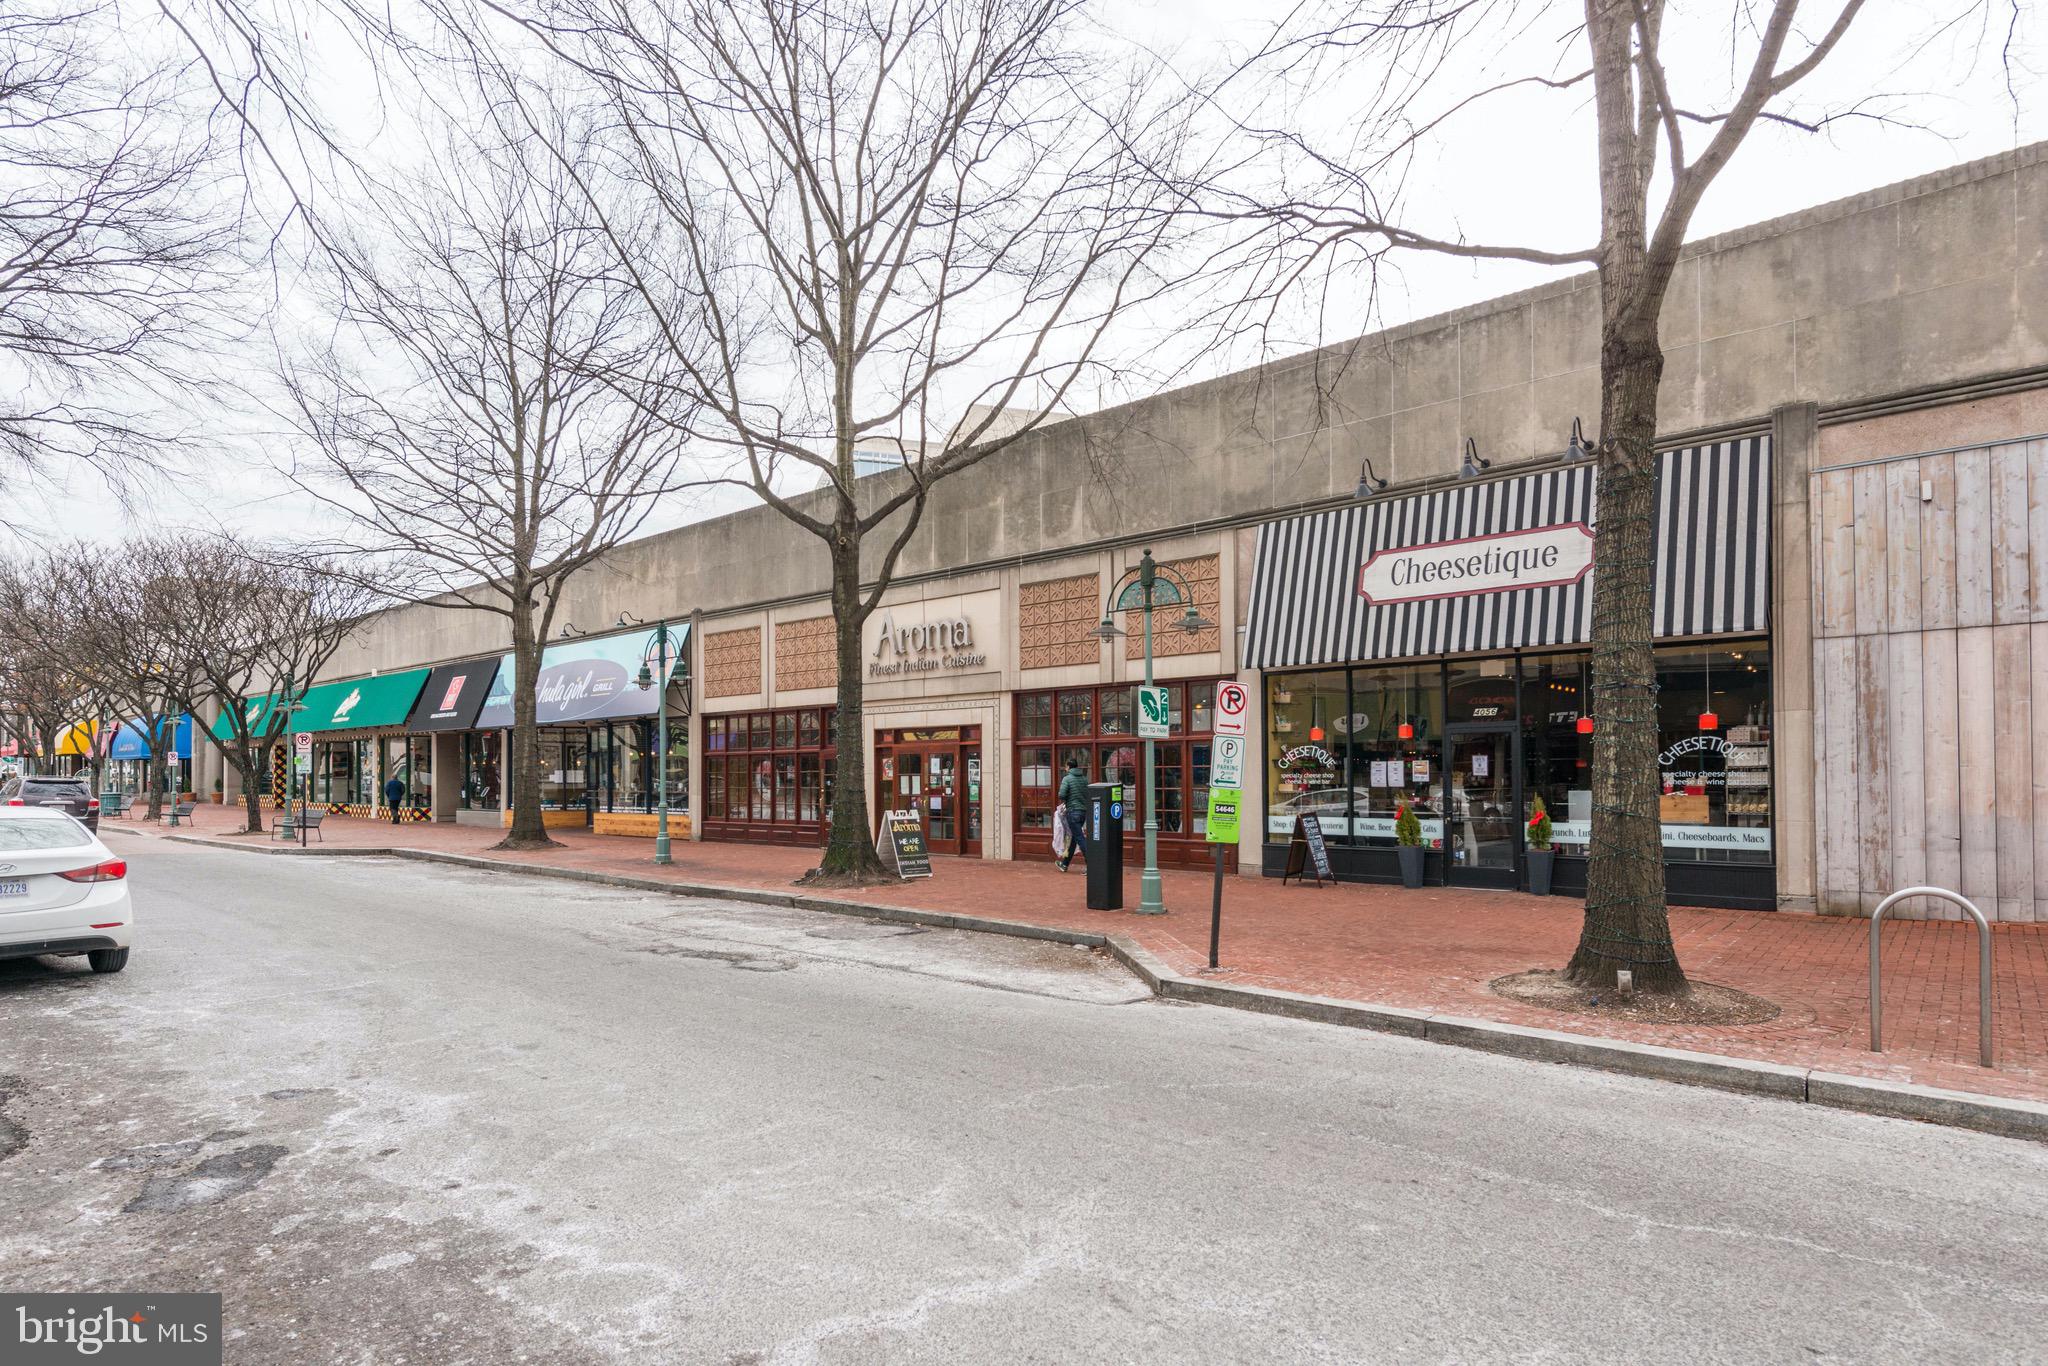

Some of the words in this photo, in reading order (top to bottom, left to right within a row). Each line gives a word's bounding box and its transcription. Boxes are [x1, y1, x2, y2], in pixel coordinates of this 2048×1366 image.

[1390, 544, 1559, 587] Cheesetique
[873, 613, 974, 658] Aroma
[869, 660, 903, 677] Finest
[904, 657, 940, 673] Indian
[942, 653, 986, 670] Cuisine
[592, 682, 614, 692] GRILL
[1161, 692, 1168, 704] 2
[1474, 708, 1497, 717] 4056
[1278, 745, 1337, 770] CHEESETIQUE
[1216, 763, 1239, 772] PARKING
[1220, 771, 1226, 780] 2
[1706, 778, 1726, 786] wine
[892, 820, 921, 832] Aroma
[899, 837, 909, 845] WE
[910, 837, 920, 845] ARE
[1742, 833, 1765, 843] Macs
